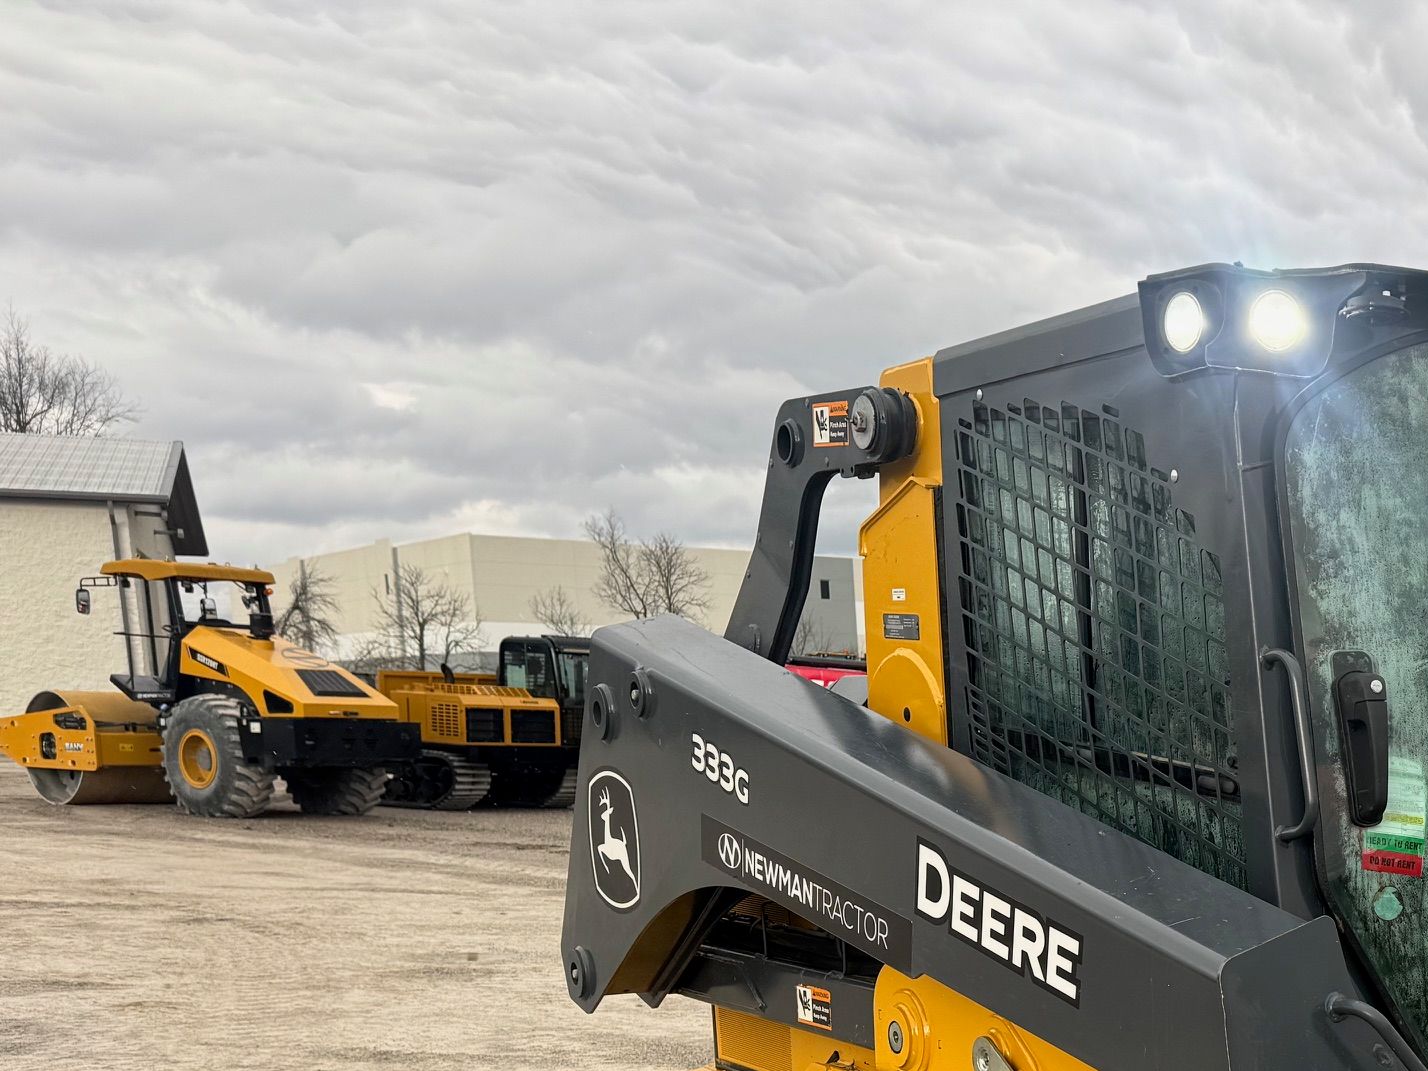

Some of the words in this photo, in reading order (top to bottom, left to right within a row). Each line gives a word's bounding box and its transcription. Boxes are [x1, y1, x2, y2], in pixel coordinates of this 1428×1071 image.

[691, 733, 749, 804] 333G
[1369, 855, 1380, 865] DO
[1382, 857, 1395, 867] NOT
[1397, 859, 1416, 871] RENT
[1394, 839, 1403, 849] TO
[1404, 841, 1423, 852] RENT
[917, 843, 1080, 1000] DEERE
